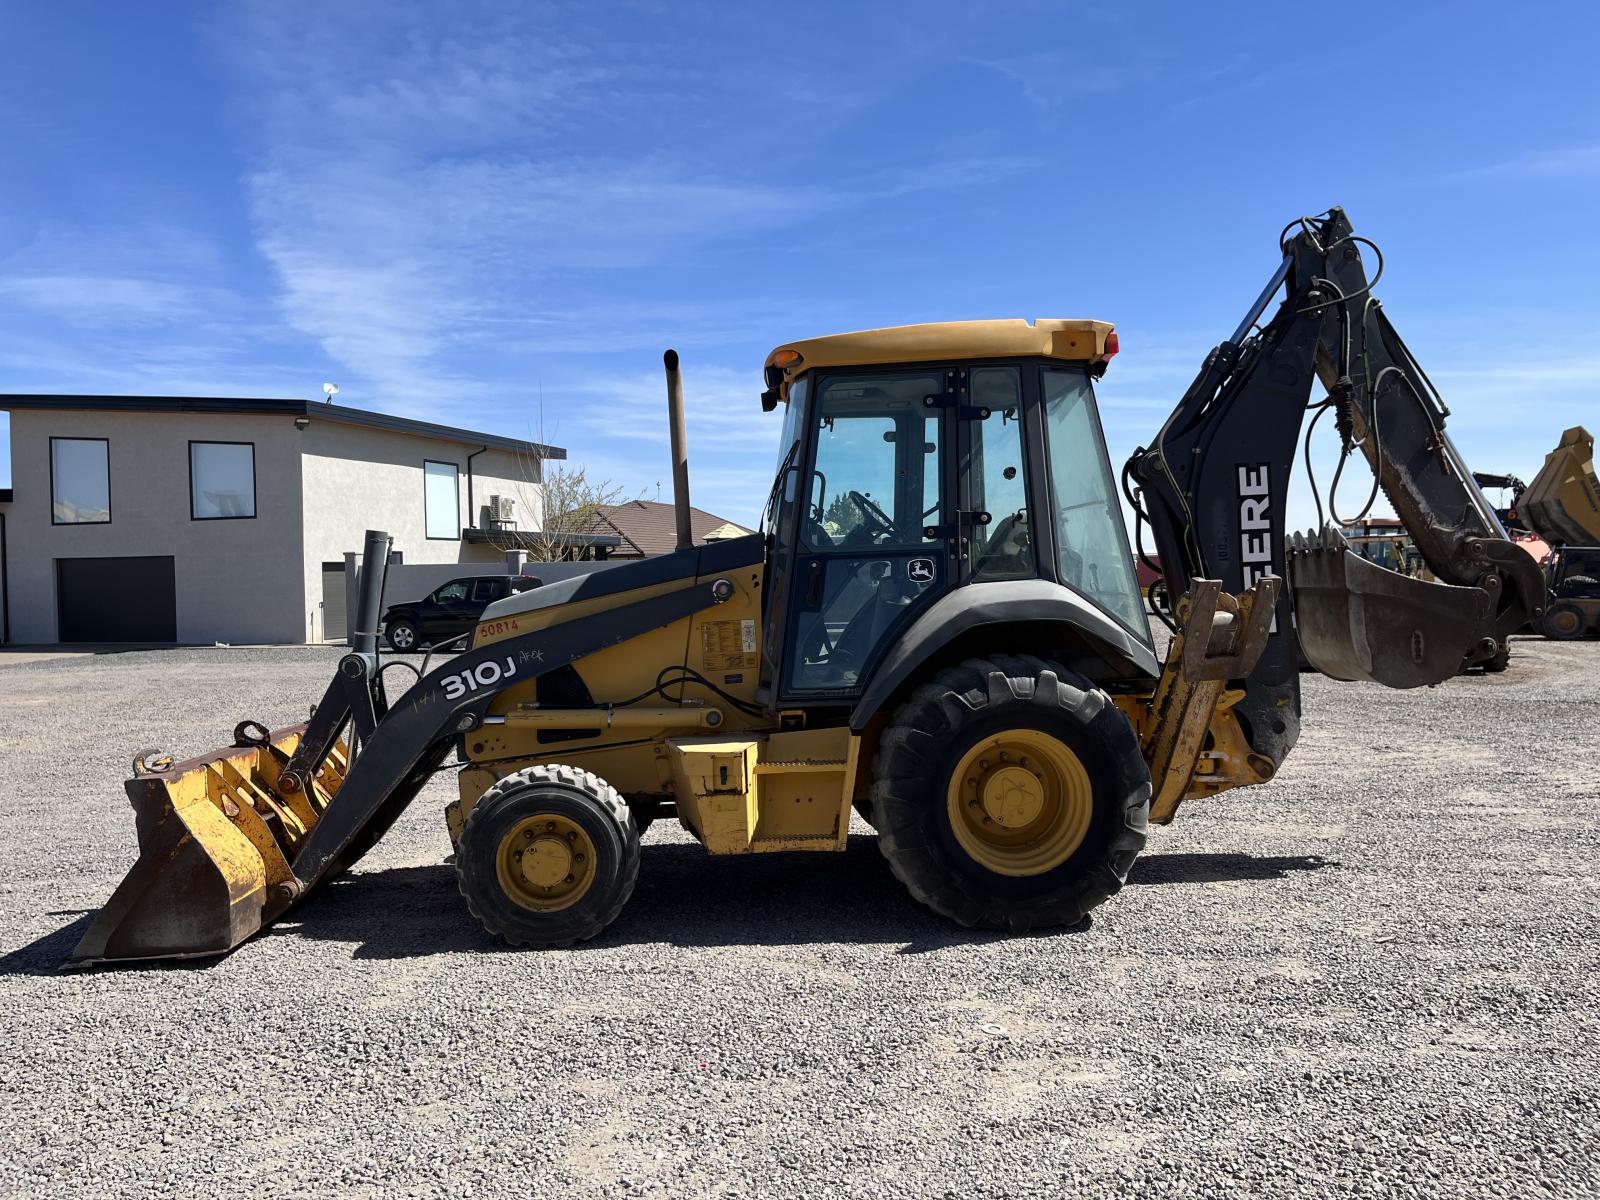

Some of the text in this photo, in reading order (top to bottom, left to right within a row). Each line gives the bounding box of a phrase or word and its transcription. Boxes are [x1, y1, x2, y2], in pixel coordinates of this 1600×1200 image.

[1238, 466, 1277, 633] EERE
[480, 619, 519, 638] 60814
[440, 656, 517, 700] 310J
